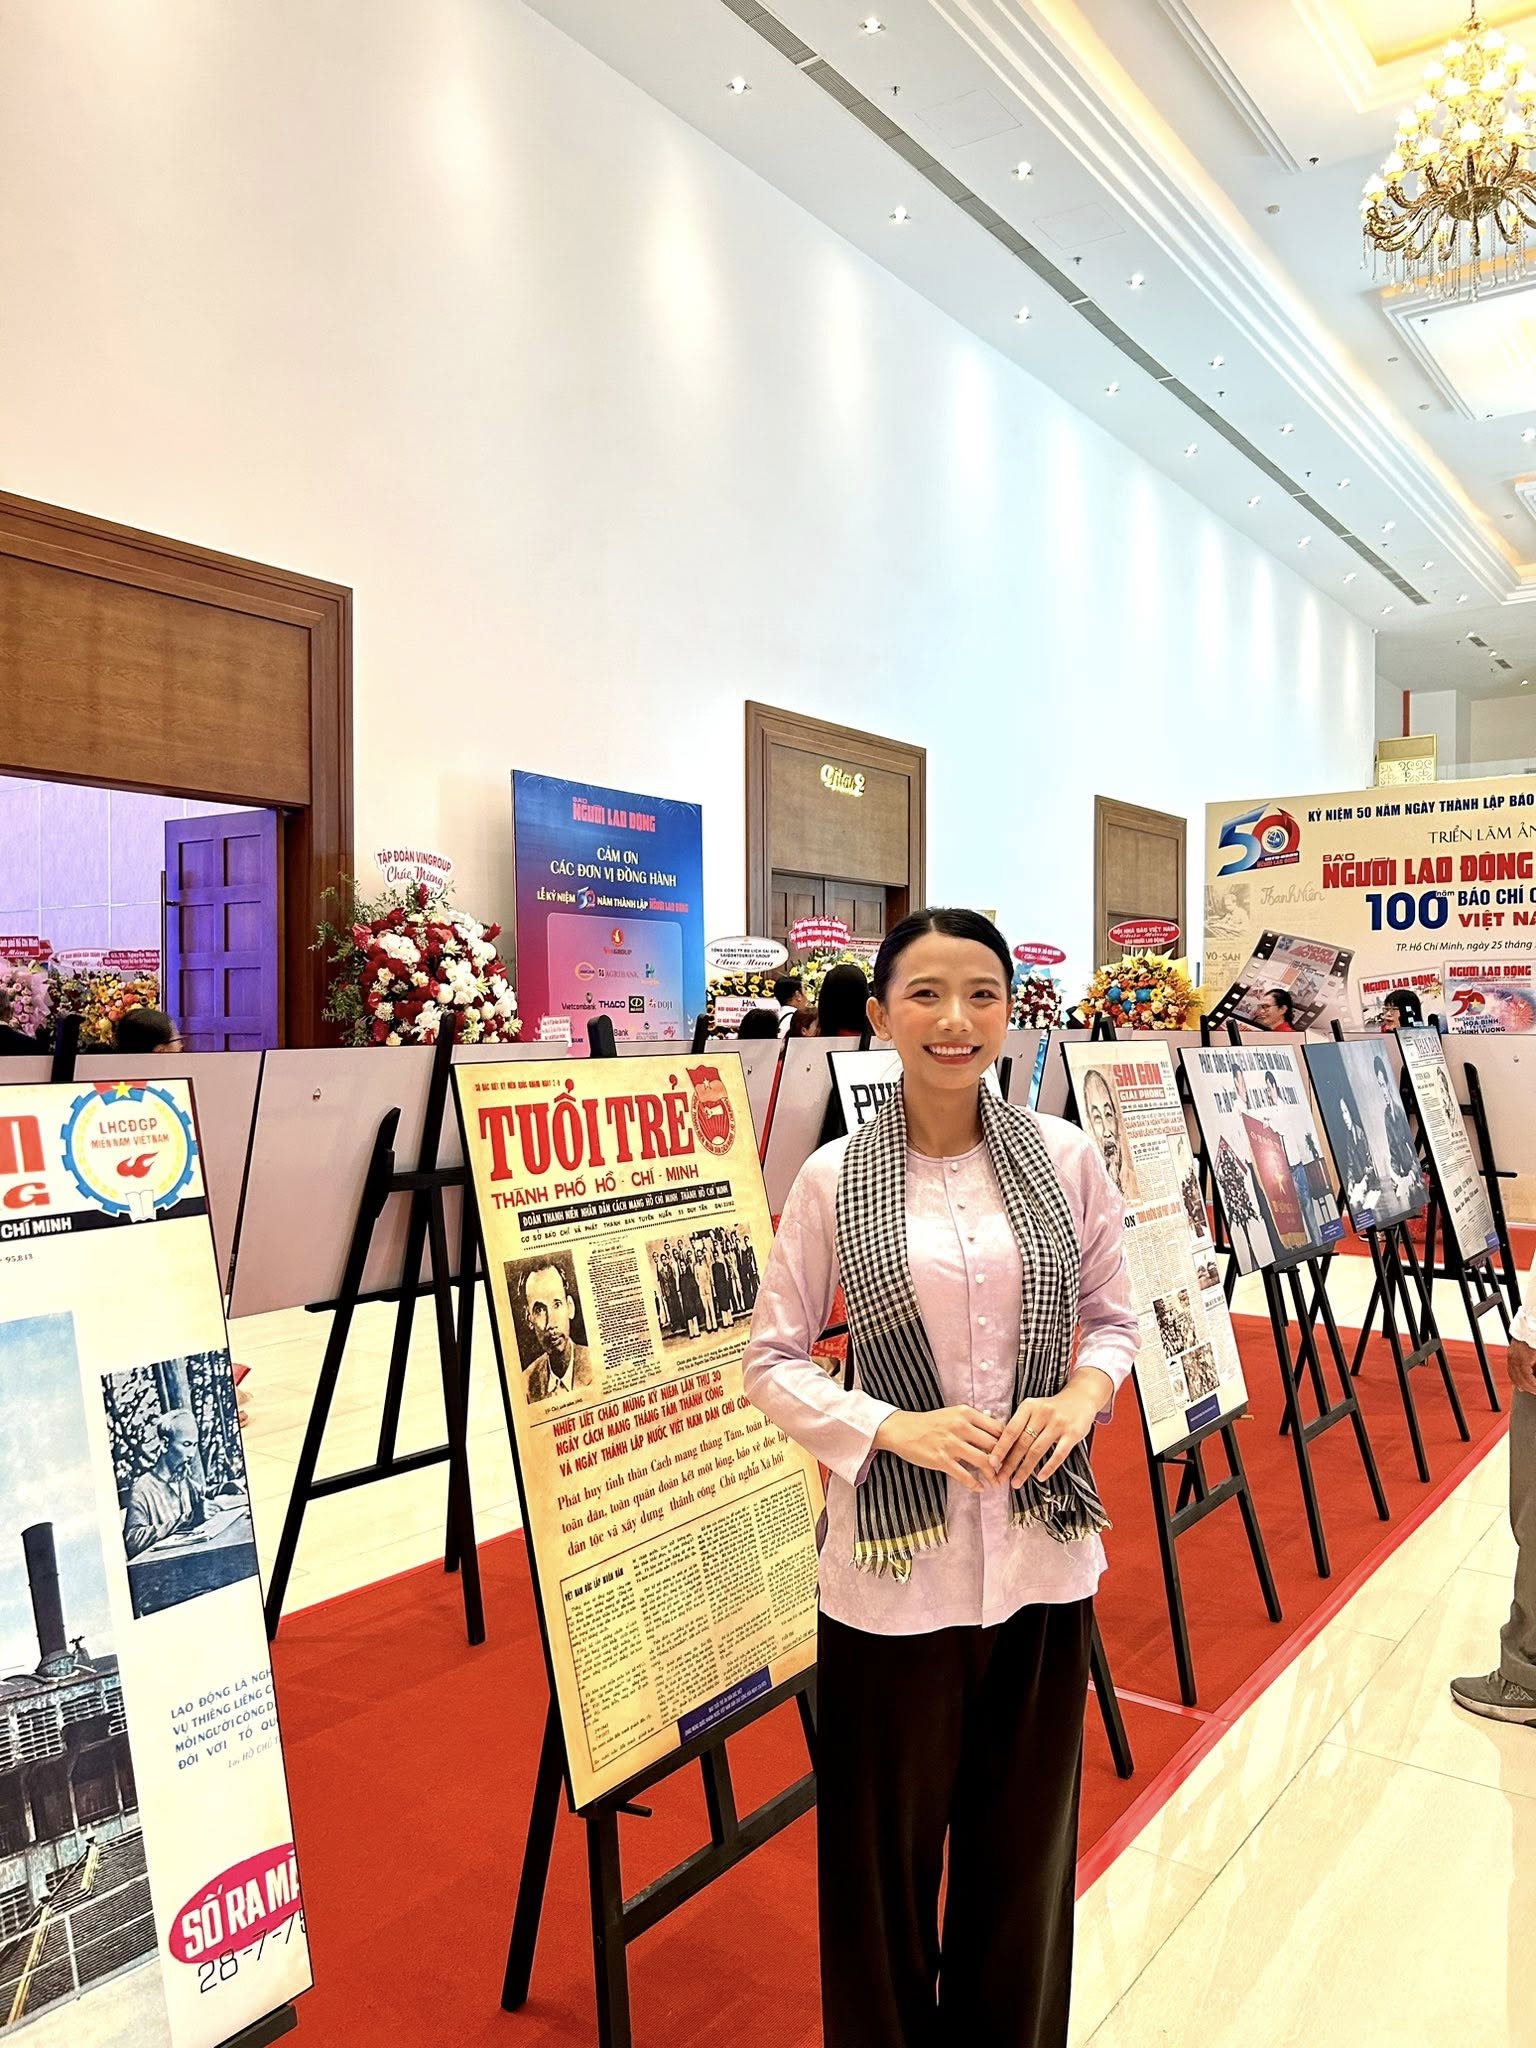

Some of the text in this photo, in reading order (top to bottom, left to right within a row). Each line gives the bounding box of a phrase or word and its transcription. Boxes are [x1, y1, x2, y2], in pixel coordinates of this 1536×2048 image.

[607, 808, 627, 828] LAO
[629, 811, 656, 833] ĐỘNG
[1308, 793, 1535, 823] KỶ NIỆM 50 NĂM NGÀY THÀNH LẬP BÁO
[1428, 824, 1472, 844] TRIỂN
[1477, 825, 1512, 842] LÃM
[377, 846, 452, 872] TẬP ĐOÀN VINGROUP
[597, 845, 639, 865] CẢM ƠN
[1322, 853, 1355, 862] BÁO
[1322, 851, 1534, 889] NGƯỜI LAO ĐỘNG
[387, 866, 412, 883] Chúc
[550, 859, 676, 887] CÁC ĐƠN VỊ ĐỒNG HÀNH
[1365, 890, 1449, 931] 100
[1458, 886, 1490, 907] BÁO
[1496, 885, 1524, 906] CHÍ
[1458, 909, 1505, 931] VIỆT
[1396, 943, 1408, 952] TP.
[1423, 942, 1438, 951] Chí
[1439, 941, 1464, 952] Minh,
[1466, 942, 1490, 953] ngày
[1491, 941, 1502, 950] 25
[1504, 939, 1532, 952] tháng
[1392, 977, 1409, 988] LAO
[1449, 965, 1532, 977] NGƯỜI LAO ĐỘNG
[598, 1000, 626, 1009] THACO
[99, 1118, 158, 1134] LHCĐGP
[478, 1078, 605, 1182] TUỔI
[605, 1073, 695, 1164] TRẺ
[490, 1164, 699, 1210] THÀNH PHỐ HỒ CHÍ MINH
[522, 1212, 541, 1227] ĐOÀN
[542, 1211, 565, 1223] THANH
[598, 1201, 612, 1215] DÂN
[612, 1199, 627, 1213] CÁCH
[628, 1198, 645, 1211] MẠNG
[645, 1194, 654, 1206] HỒ
[654, 1192, 664, 1204] CHÍ
[665, 1192, 679, 1203] MINH
[1, 1216, 72, 1239] CHÍ MINH
[598, 1402, 619, 1421] CHÀO
[623, 1395, 646, 1414] MỪNG
[712, 1370, 722, 1382] 30
[556, 1435, 579, 1456] NGÀY
[583, 1428, 605, 1446] CÁCH
[634, 1408, 659, 1428] THÁNG
[661, 1401, 678, 1418] TÁM
[679, 1391, 704, 1411] THÀNH
[705, 1385, 724, 1402] CÔNG
[559, 1459, 573, 1477] VÀ
[575, 1451, 598, 1472] NGÀY
[601, 1440, 629, 1462] THÀNH
[630, 1433, 645, 1452] LẬP
[646, 1424, 668, 1445] NƯỚC
[686, 1412, 704, 1429] NAM
[705, 1406, 720, 1423] DÂN
[722, 1398, 735, 1415] CHỦ
[737, 1394, 751, 1410] CÔN
[557, 1491, 582, 1511] Phát
[584, 1484, 601, 1500] huy
[651, 1455, 672, 1473] Cách
[700, 1436, 723, 1453] tháng
[568, 1540, 586, 1557] dân
[589, 1532, 604, 1548] tộc
[669, 1490, 694, 1511] thành
[171, 1702, 194, 1719] LAO
[198, 1686, 230, 1707] ĐỘNG
[235, 1677, 248, 1692] LÀ
[173, 1689, 262, 1736] VỤ THIÊNG LIÊNG
[198, 1719, 235, 1743] NGƯỜI
[236, 1705, 265, 1725] CÔNG
[178, 1753, 199, 1770] ĐỐI
[206, 1740, 227, 1757] VỚI
[181, 1883, 224, 1960] SỐ
[225, 1877, 267, 1936] RA
